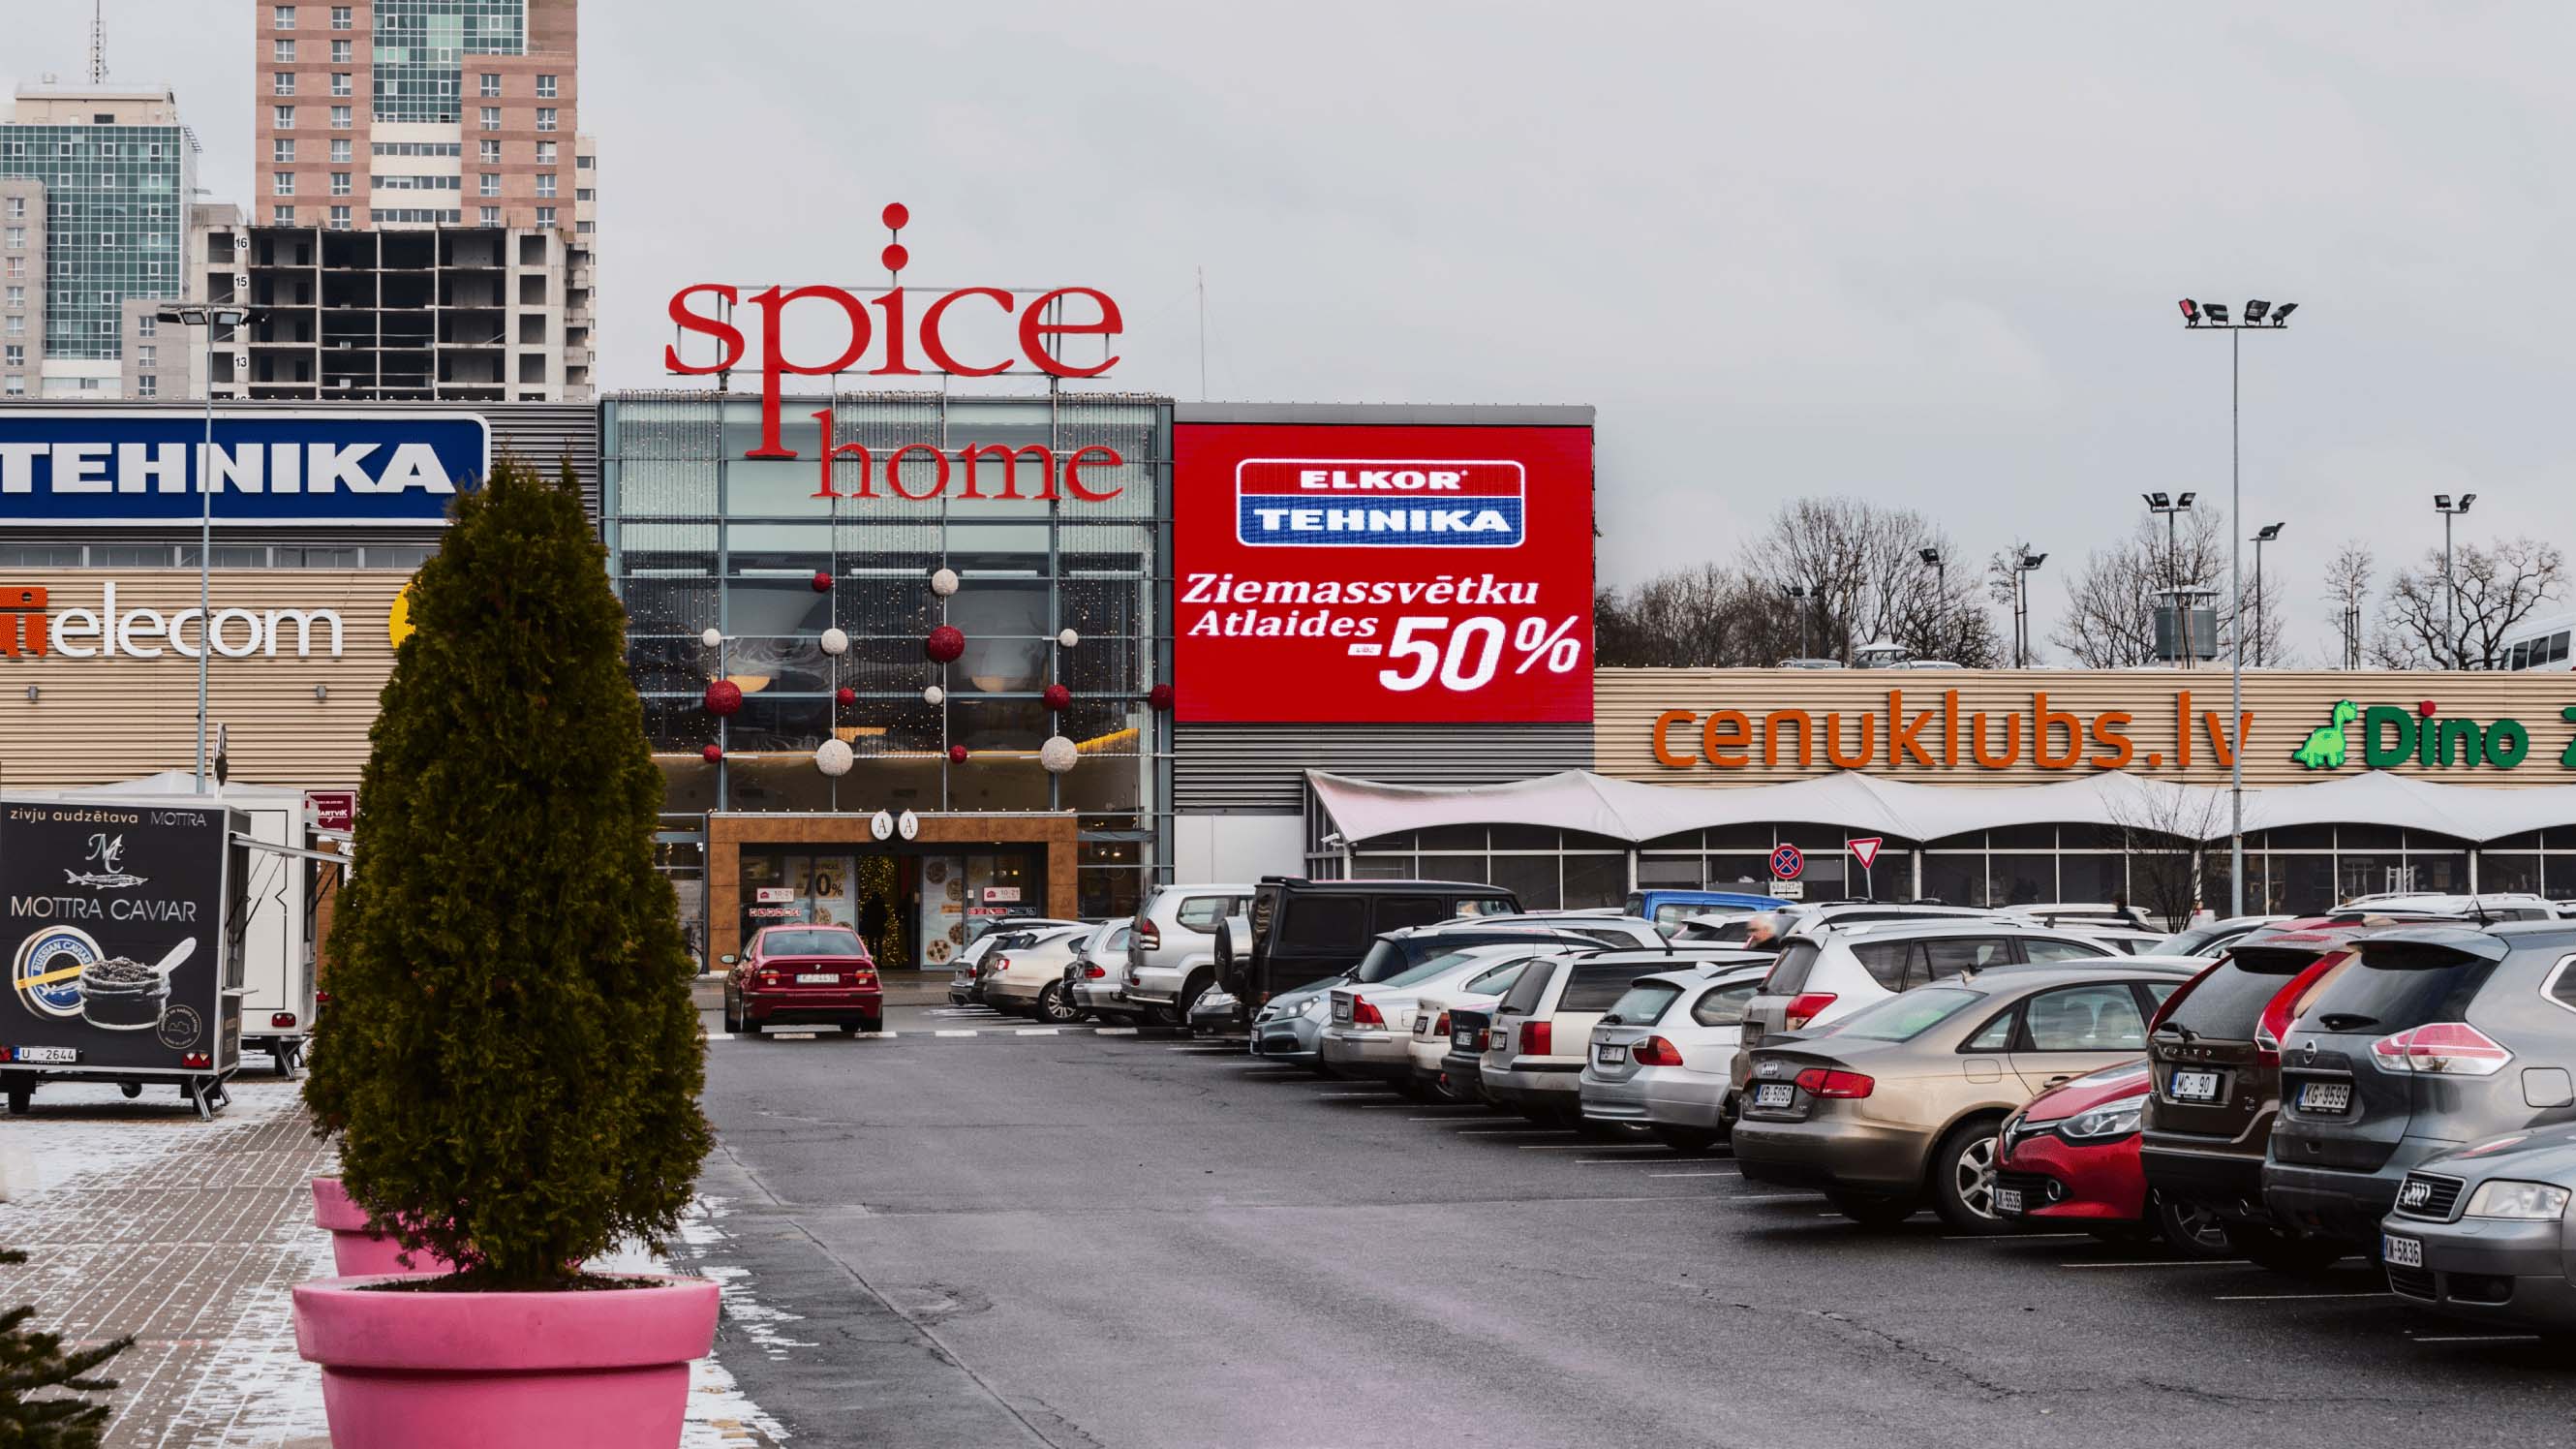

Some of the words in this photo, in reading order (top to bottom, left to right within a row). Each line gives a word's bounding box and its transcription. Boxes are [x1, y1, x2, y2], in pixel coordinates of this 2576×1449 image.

[235, 237, 248, 248] 16
[235, 276, 248, 287] 15
[665, 202, 1123, 458] spice
[235, 356, 248, 367] 13
[811, 408, 1123, 501] home
[0, 443, 455, 493] TEHNIKA
[1254, 509, 1512, 533] TEHNIKA
[1181, 572, 1539, 605] Ziemassvētku
[1187, 609, 1379, 638] Atlaides
[1653, 689, 2254, 769] cenuklubs.lv
[2365, 699, 2530, 768] Dino
[10, 809, 46, 823] zivju
[52, 811, 139, 823] audzētava
[151, 812, 207, 827] MOTTRA
[11, 896, 104, 919] MOTTRA
[110, 899, 197, 922] CAVIAR
[34, 941, 61, 971] RUSSIAN
[1760, 1085, 1792, 1102] KB-5050
[2305, 1084, 2348, 1106] KG-9599
